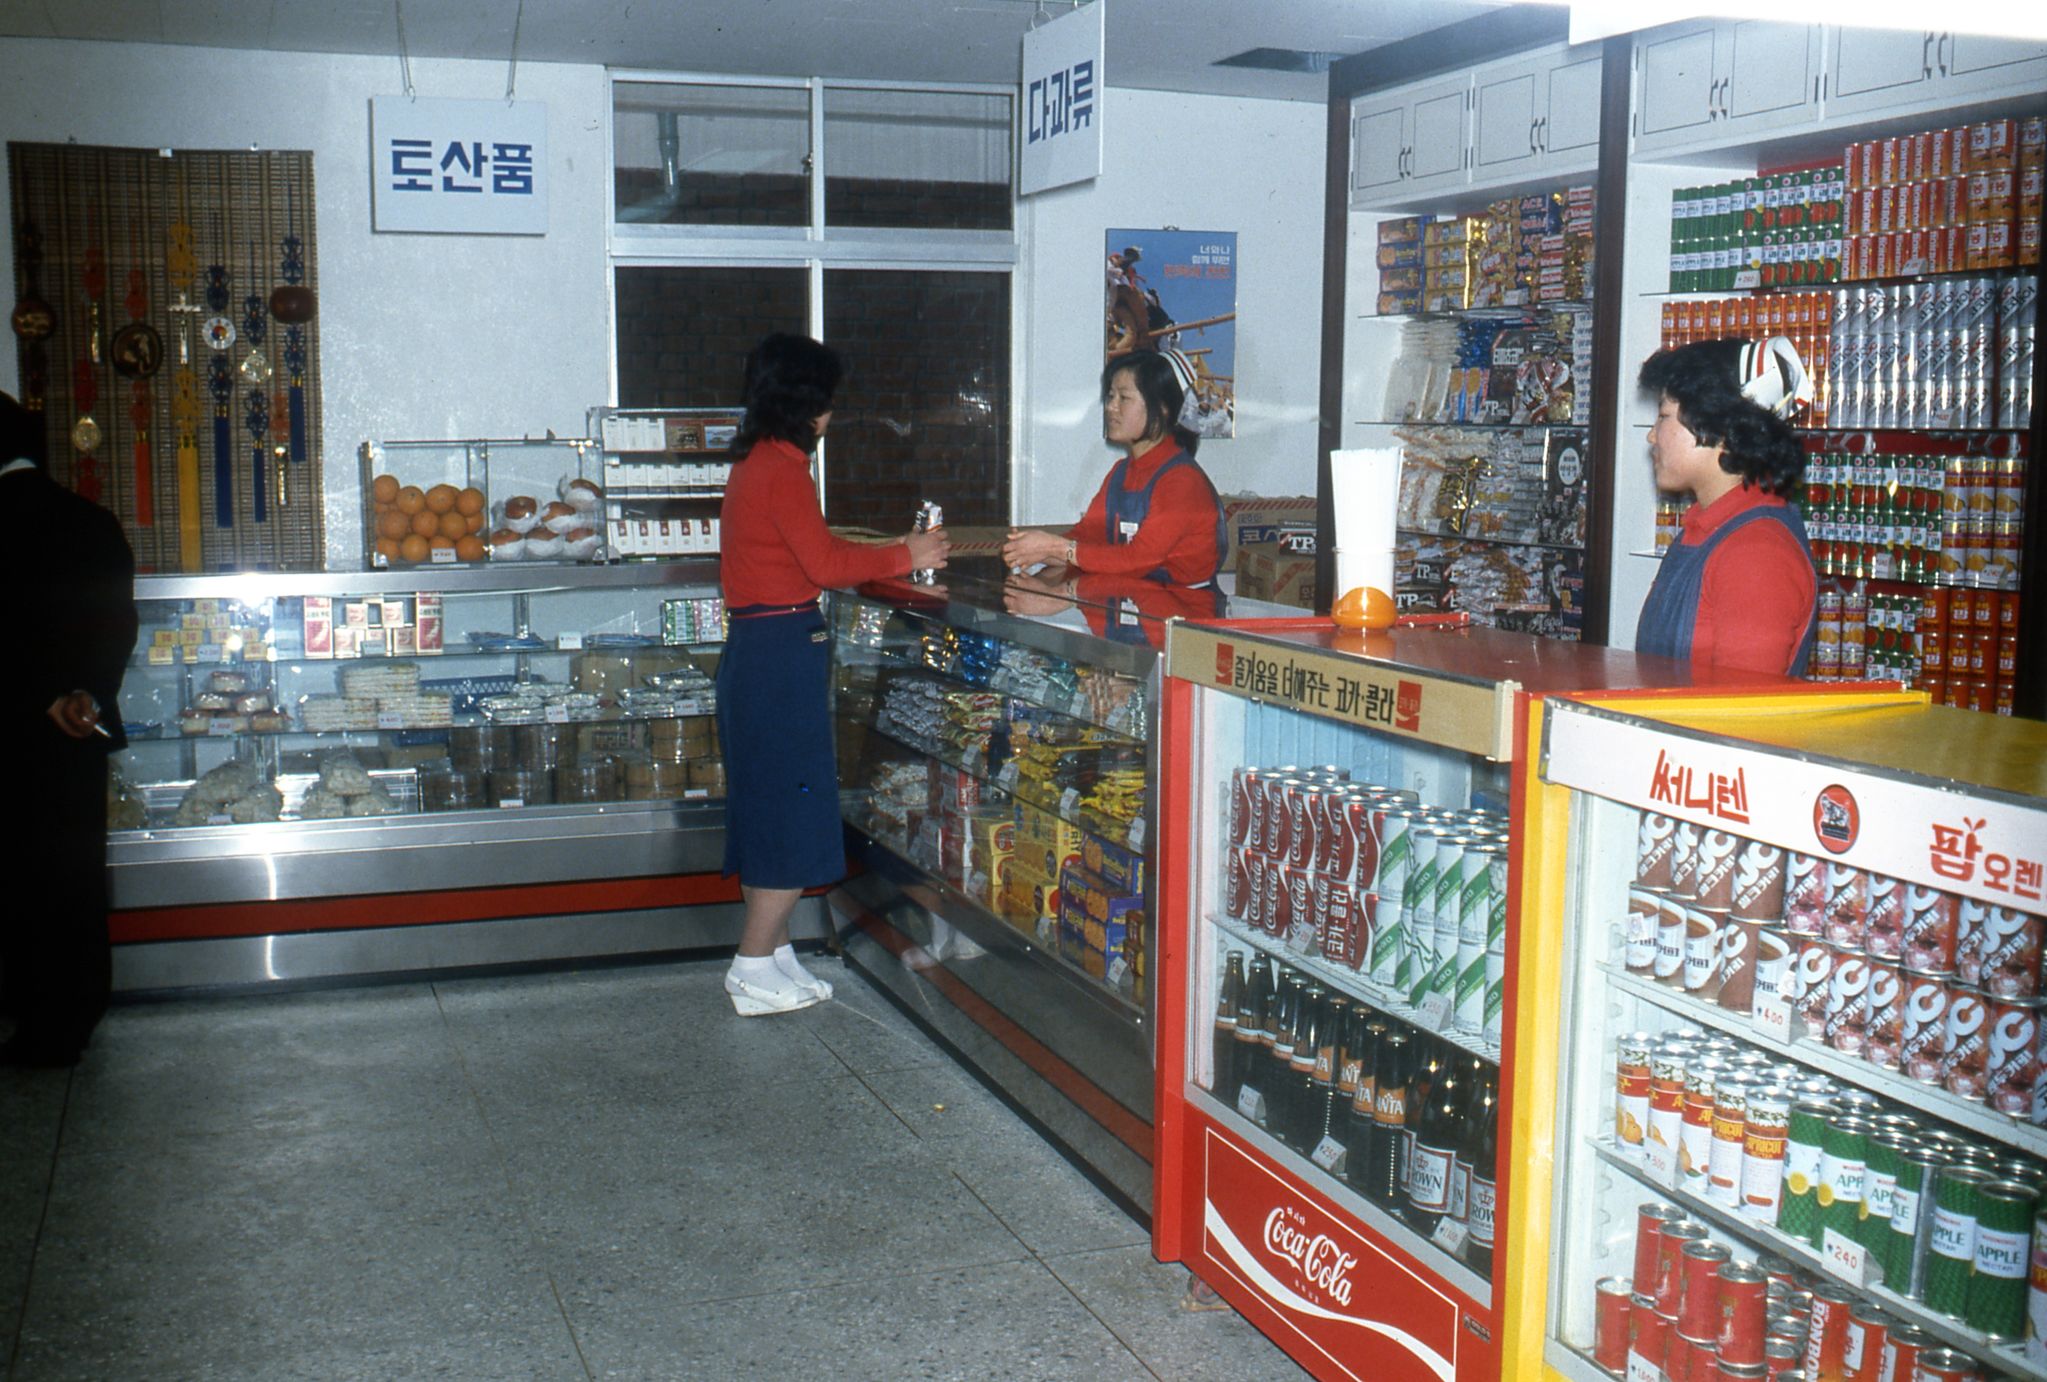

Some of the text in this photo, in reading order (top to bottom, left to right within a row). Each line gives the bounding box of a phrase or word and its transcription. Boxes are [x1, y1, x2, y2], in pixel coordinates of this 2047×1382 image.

[1028, 59, 1094, 144] 다과류
[391, 139, 533, 194] 토산품
[1235, 651, 1278, 697] 즐거움을
[1283, 658, 1330, 708] 더해주는
[1649, 749, 1750, 825] 써니텐
[1930, 816, 2046, 902] 팝오렌
[1264, 1207, 1358, 1307] Coca-Cola
[1977, 1244, 2021, 1265] APPLE
